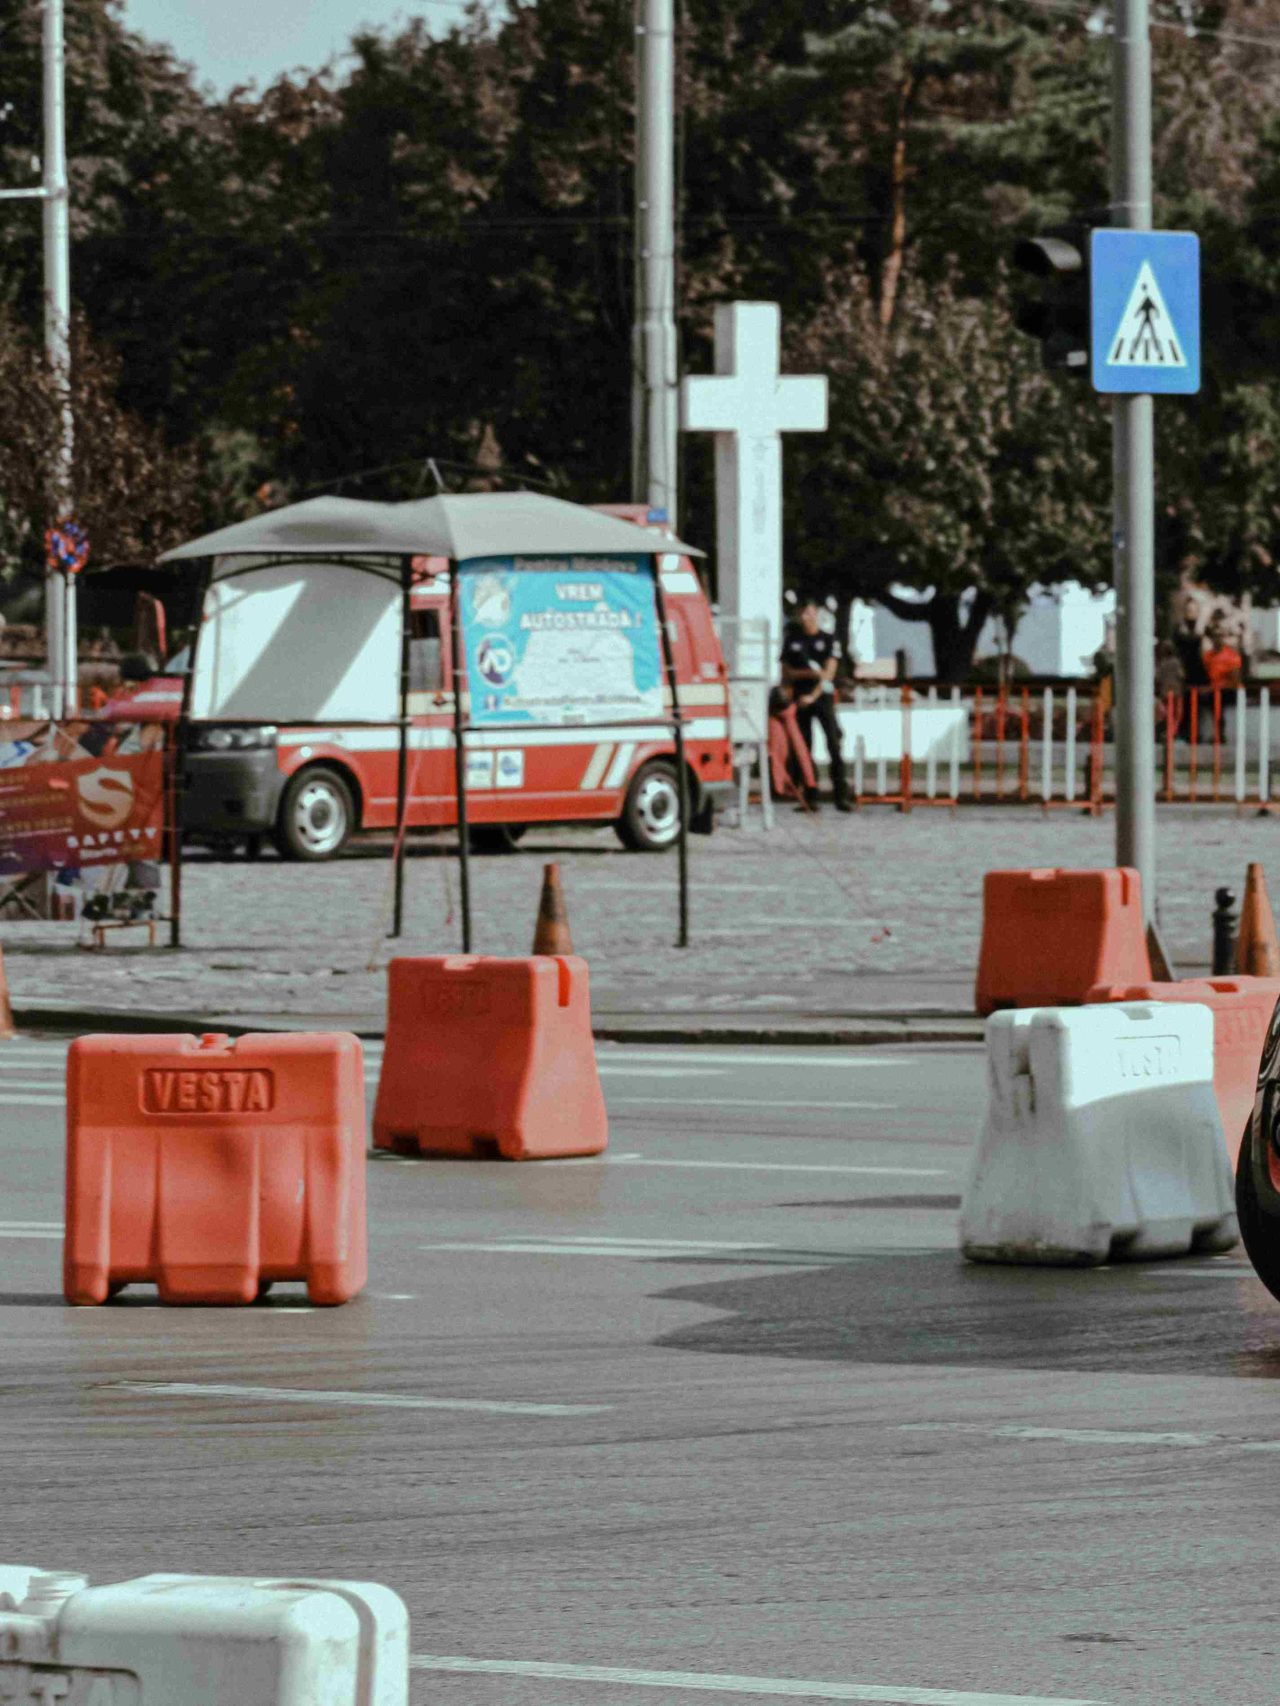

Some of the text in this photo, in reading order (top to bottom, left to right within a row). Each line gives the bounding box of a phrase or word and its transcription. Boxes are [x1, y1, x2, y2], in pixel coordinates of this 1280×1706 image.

[555, 583, 604, 600] VREM
[66, 827, 157, 849] SAFETY
[151, 1071, 271, 1112] VESTA
